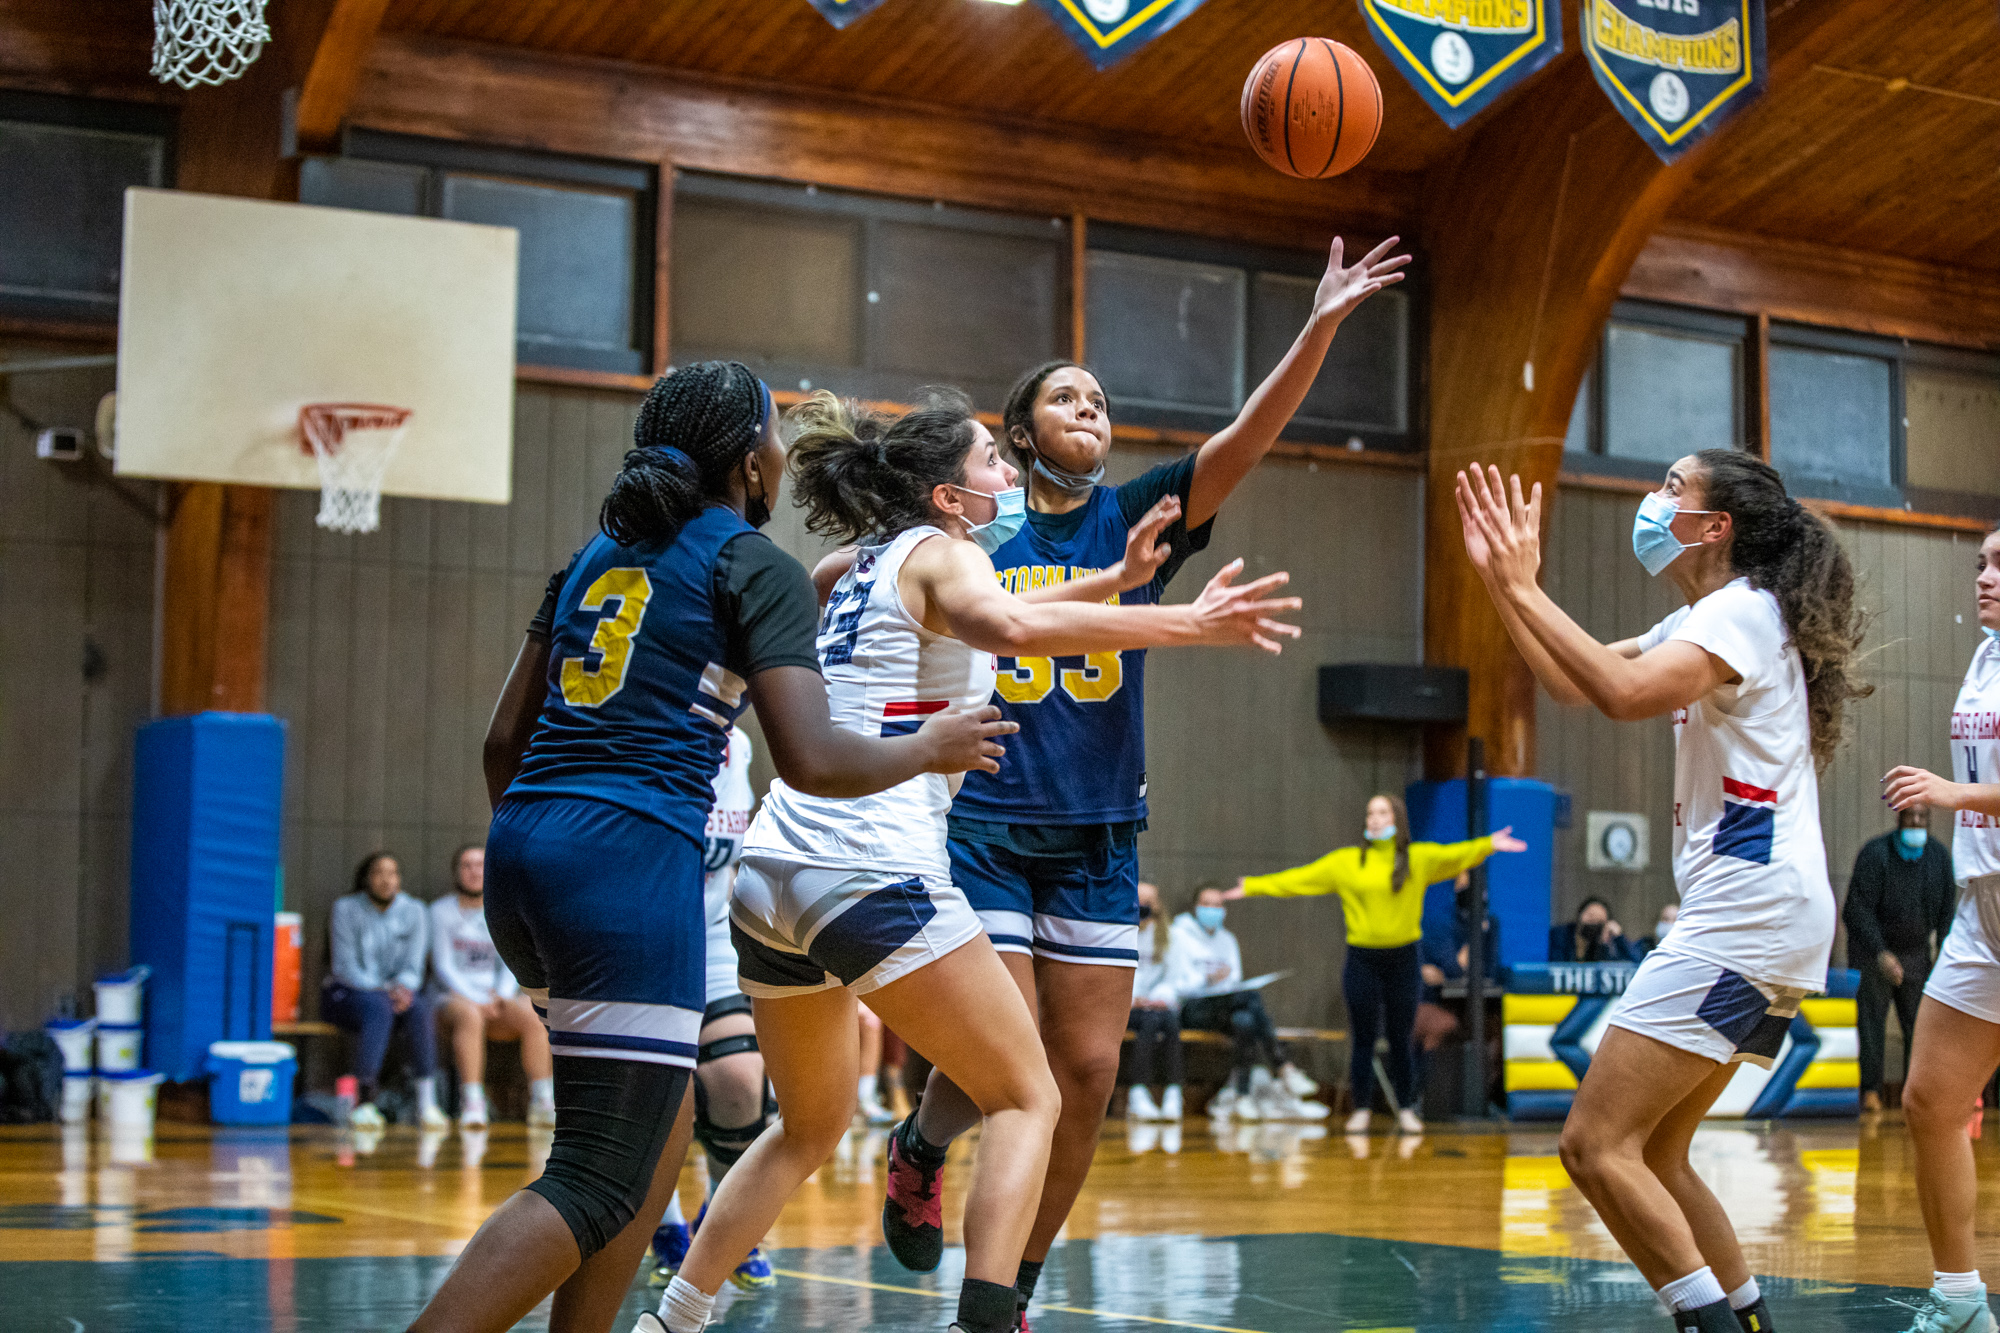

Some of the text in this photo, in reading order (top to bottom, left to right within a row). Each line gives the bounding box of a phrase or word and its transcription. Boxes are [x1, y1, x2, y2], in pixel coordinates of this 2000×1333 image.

[1596, 3, 1740, 72] CHAMPIONS
[994, 564, 1066, 595] TORM
[560, 567, 654, 708] 3
[1549, 966, 1597, 995] THE
